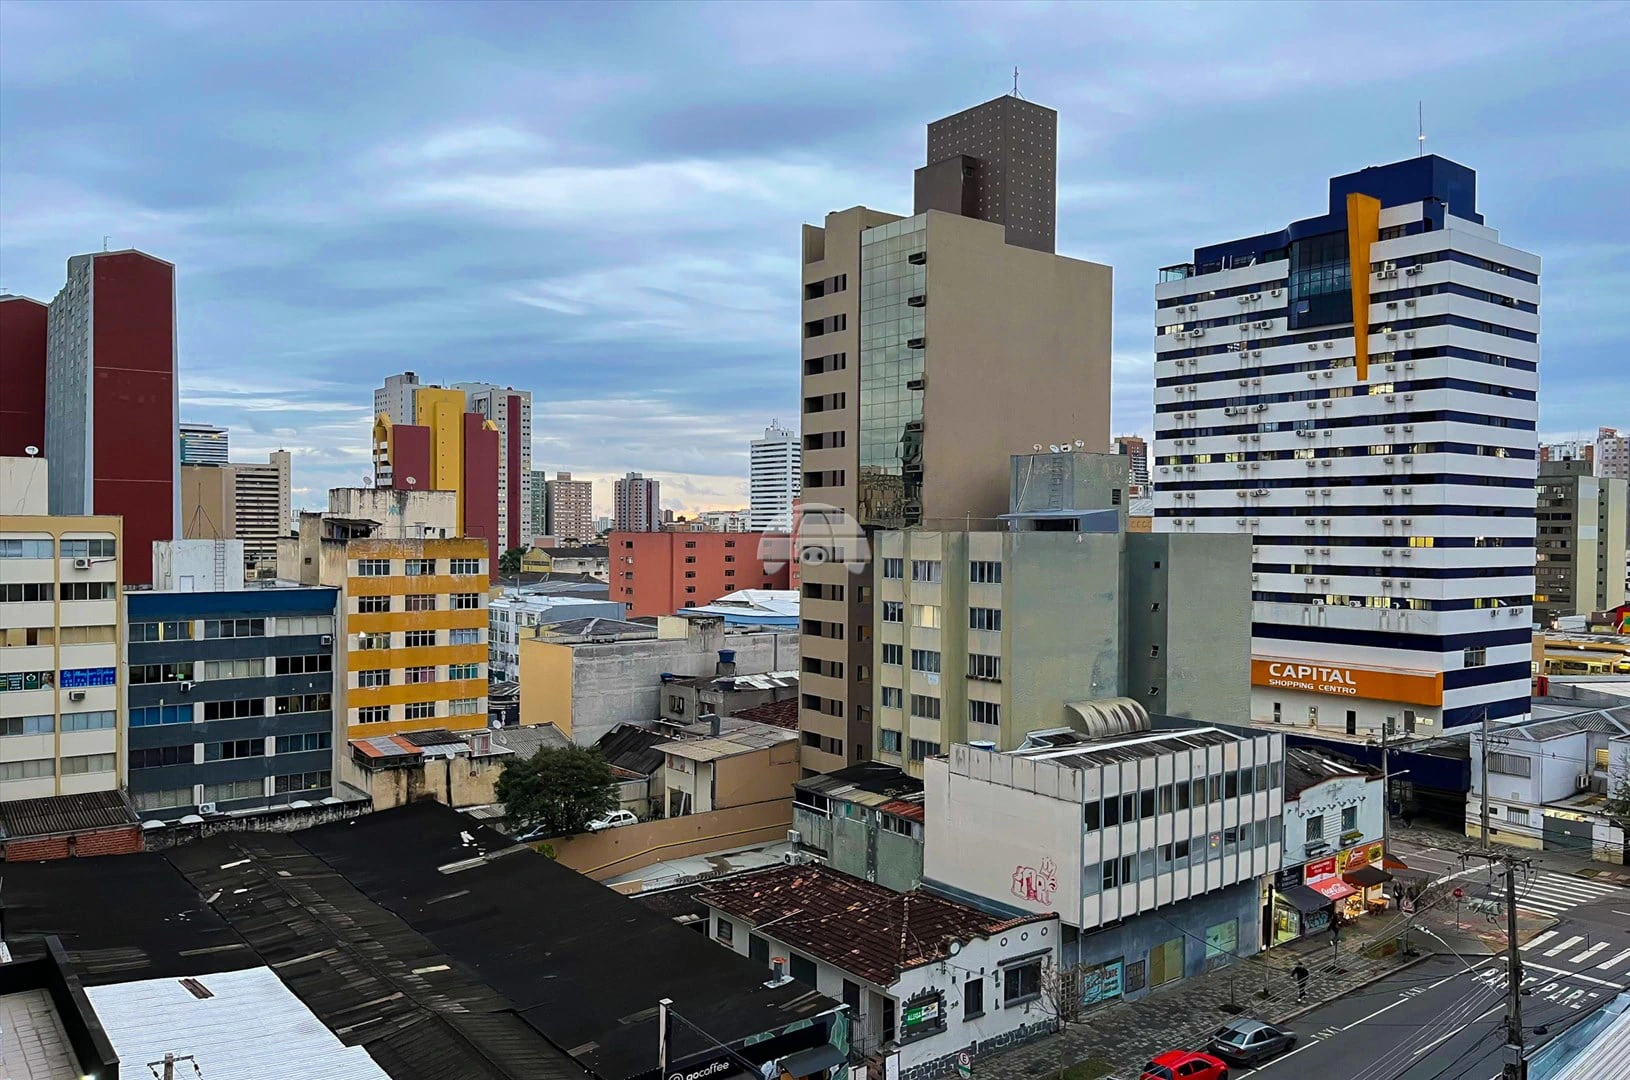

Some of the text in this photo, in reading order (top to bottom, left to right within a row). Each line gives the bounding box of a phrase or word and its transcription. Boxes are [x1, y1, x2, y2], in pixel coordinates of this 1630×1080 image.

[1269, 663, 1357, 685] CAPITAL
[1269, 679, 1357, 695] SHOPPING CENTRO
[962, 1054, 970, 1063] E
[686, 1062, 729, 1080] gocoffee
